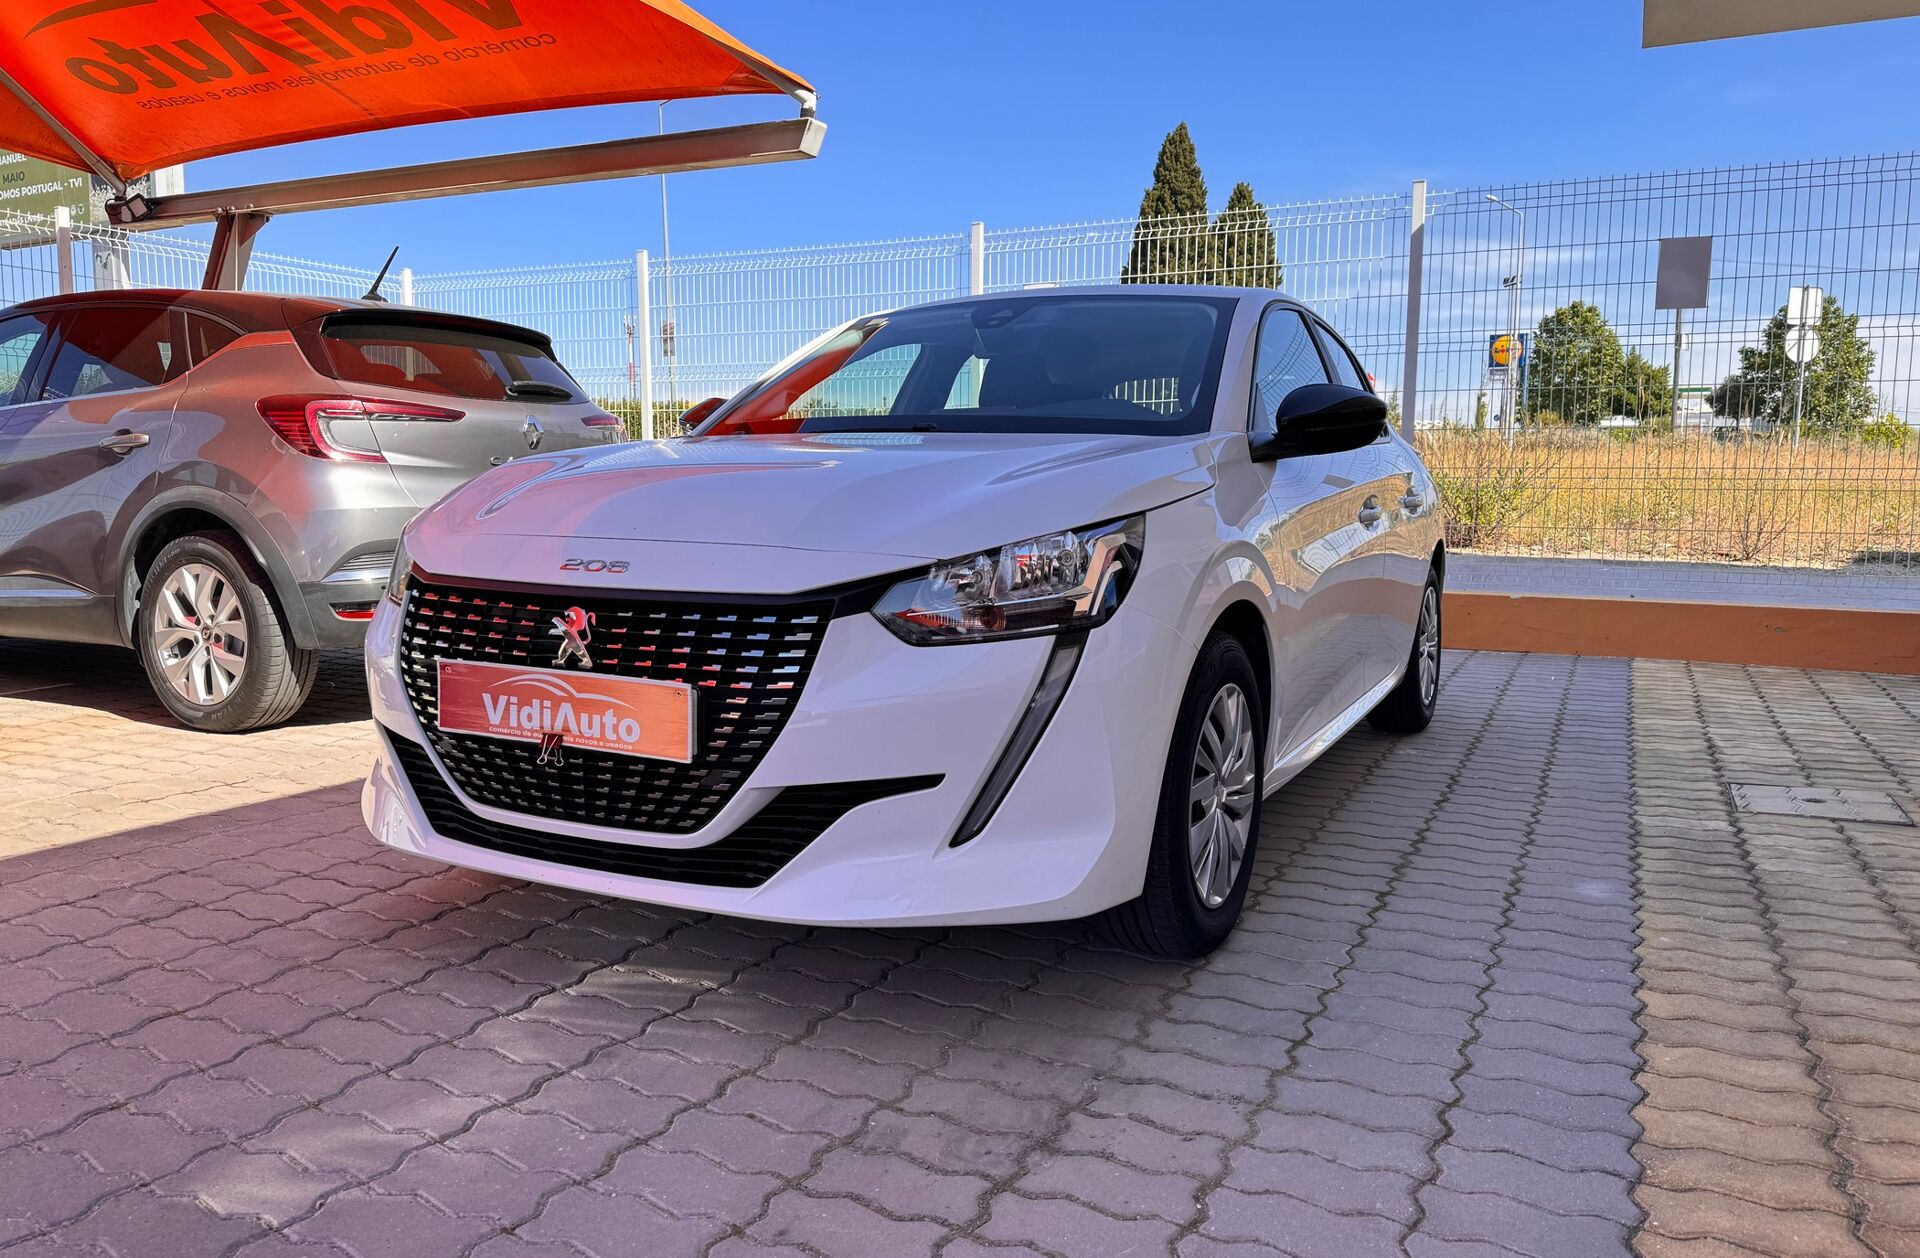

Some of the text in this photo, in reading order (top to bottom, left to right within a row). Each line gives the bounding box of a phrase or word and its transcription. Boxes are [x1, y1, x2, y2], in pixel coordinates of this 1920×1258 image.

[3, 171, 25, 184] MAIO
[22, 181, 63, 196] PORTUGAL
[69, 177, 82, 188] TVI
[560, 559, 630, 573] 208
[482, 693, 641, 743] VidiAuto
[489, 726, 521, 736] comércio
[522, 730, 532, 738] de
[575, 737, 598, 746] novos
[605, 741, 633, 751] usados
